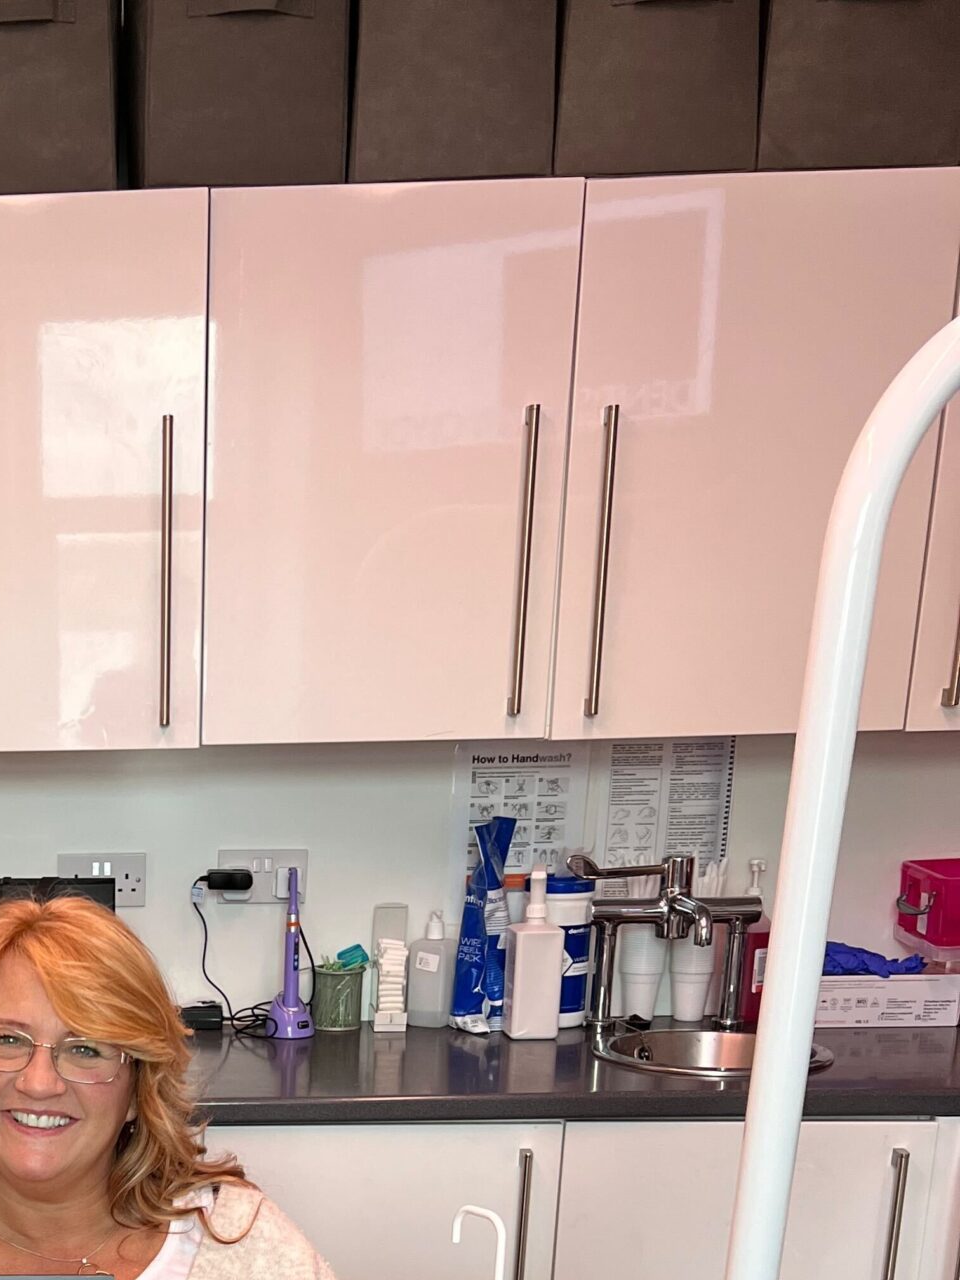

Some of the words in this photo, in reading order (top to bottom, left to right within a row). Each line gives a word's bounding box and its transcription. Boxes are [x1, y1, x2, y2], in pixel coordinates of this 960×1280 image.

[472, 755, 495, 764] How
[498, 755, 508, 763] to
[511, 753, 572, 763] Handwash?
[458, 952, 481, 963] PACK
